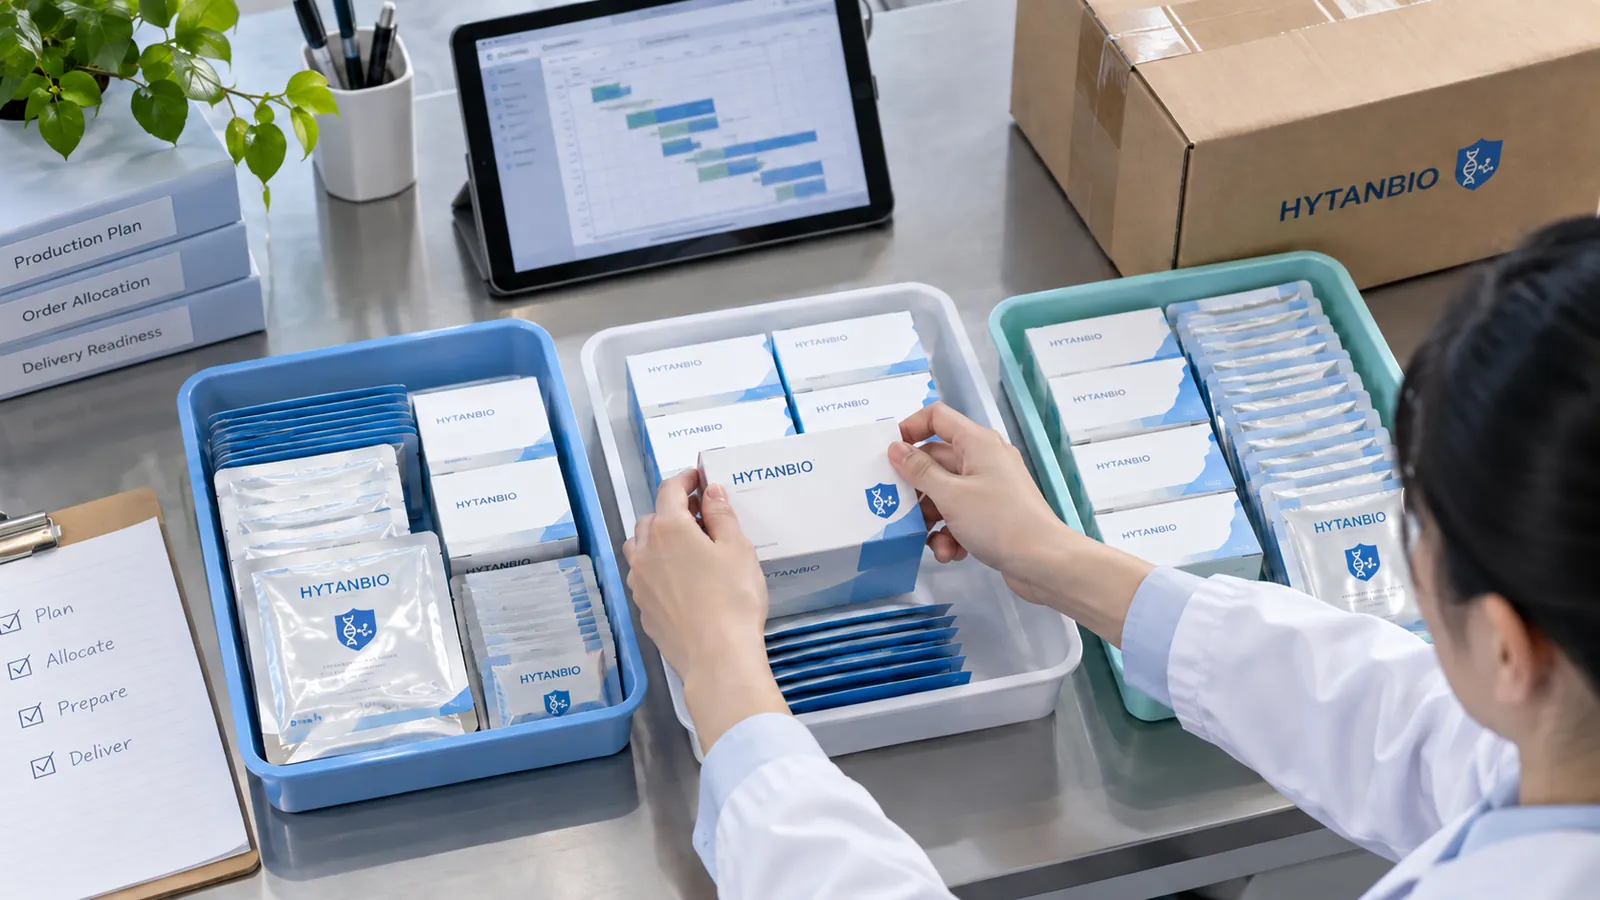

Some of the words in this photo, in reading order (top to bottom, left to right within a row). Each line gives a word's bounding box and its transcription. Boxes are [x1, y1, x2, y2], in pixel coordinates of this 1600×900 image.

[1279, 167, 1440, 222] HYTANBIO
[14, 234, 103, 269] Production
[107, 219, 142, 240] Plan
[22, 300, 67, 322] Order
[72, 276, 151, 308] Allocation
[794, 334, 848, 349] HYTANBIO
[1049, 332, 1103, 348] HYTANBIO
[22, 349, 83, 375] Delivery
[87, 327, 163, 356] Readiness
[647, 358, 703, 374] HYTANBIO
[816, 398, 870, 414] HYTANBIO
[1073, 388, 1127, 404] HYTANBIO
[436, 408, 496, 425] HYTANBIO
[668, 422, 724, 439] HYTANBIO
[732, 460, 814, 485] HYTANBIO
[1096, 454, 1151, 471] HYTANBIO
[456, 491, 518, 509] HYTANBIO
[1121, 523, 1177, 540] HYTANBIO
[1314, 511, 1387, 534] HYTANBIO
[763, 564, 820, 579] YTANBIO
[300, 573, 391, 599] HYTANBIO
[35, 603, 74, 624] Plan
[46, 638, 116, 669] Allocate
[520, 665, 581, 685] HYTANBIO
[57, 686, 128, 716] Prepare
[69, 738, 133, 767] Deliver
